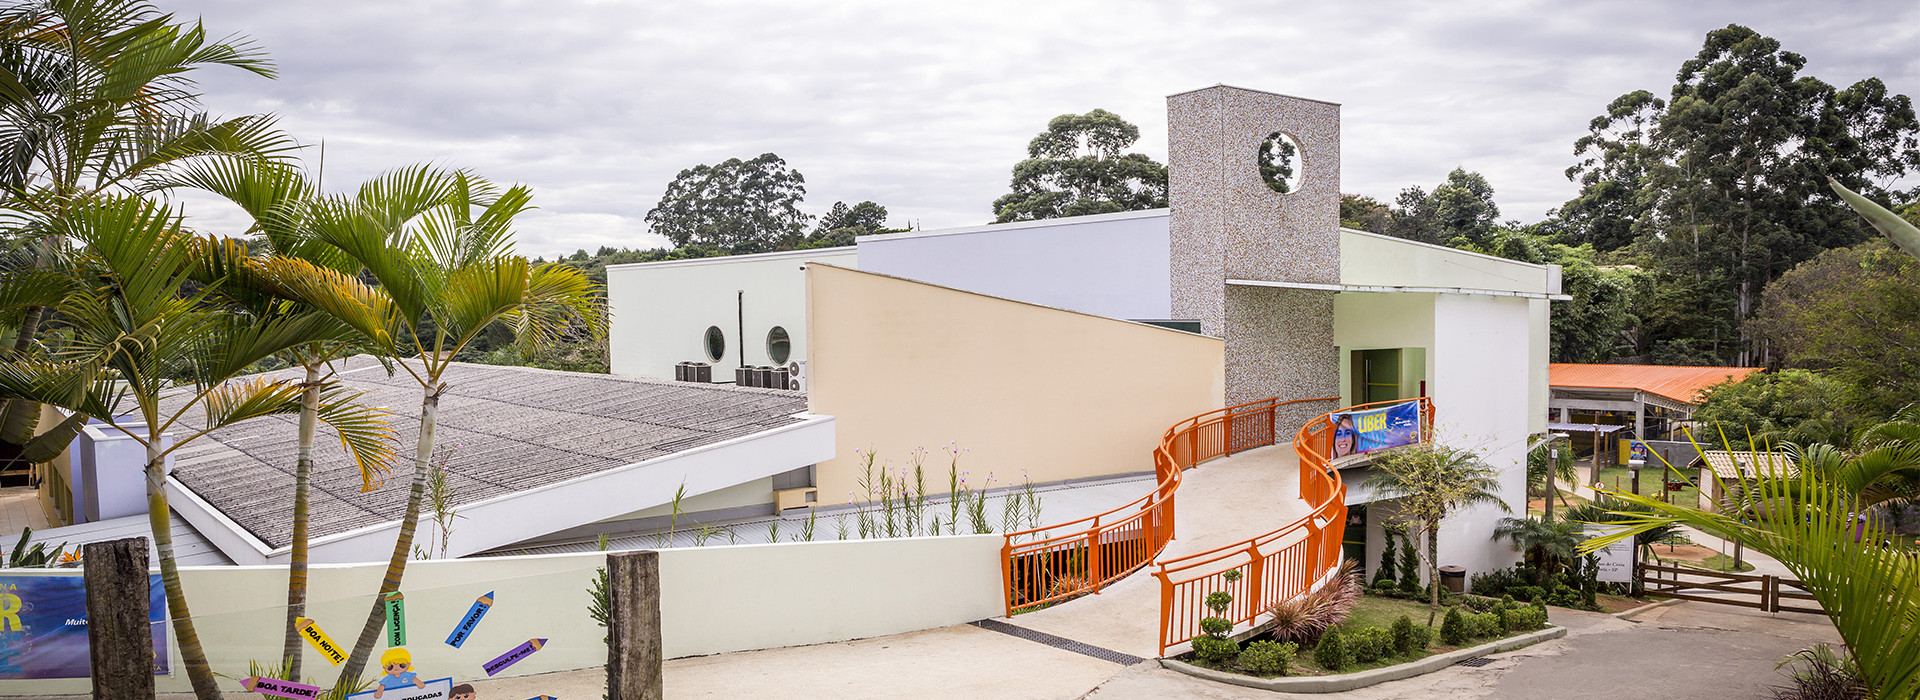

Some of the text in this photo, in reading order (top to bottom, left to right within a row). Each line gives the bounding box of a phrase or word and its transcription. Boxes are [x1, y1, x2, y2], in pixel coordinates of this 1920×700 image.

[1358, 413, 1387, 433] LIBER
[450, 604, 487, 647] POR FAVOR!
[305, 626, 345, 664] BOA NOITE!
[485, 644, 535, 673] DESCULPE-ME!
[257, 682, 318, 698] BOA TARDE!
